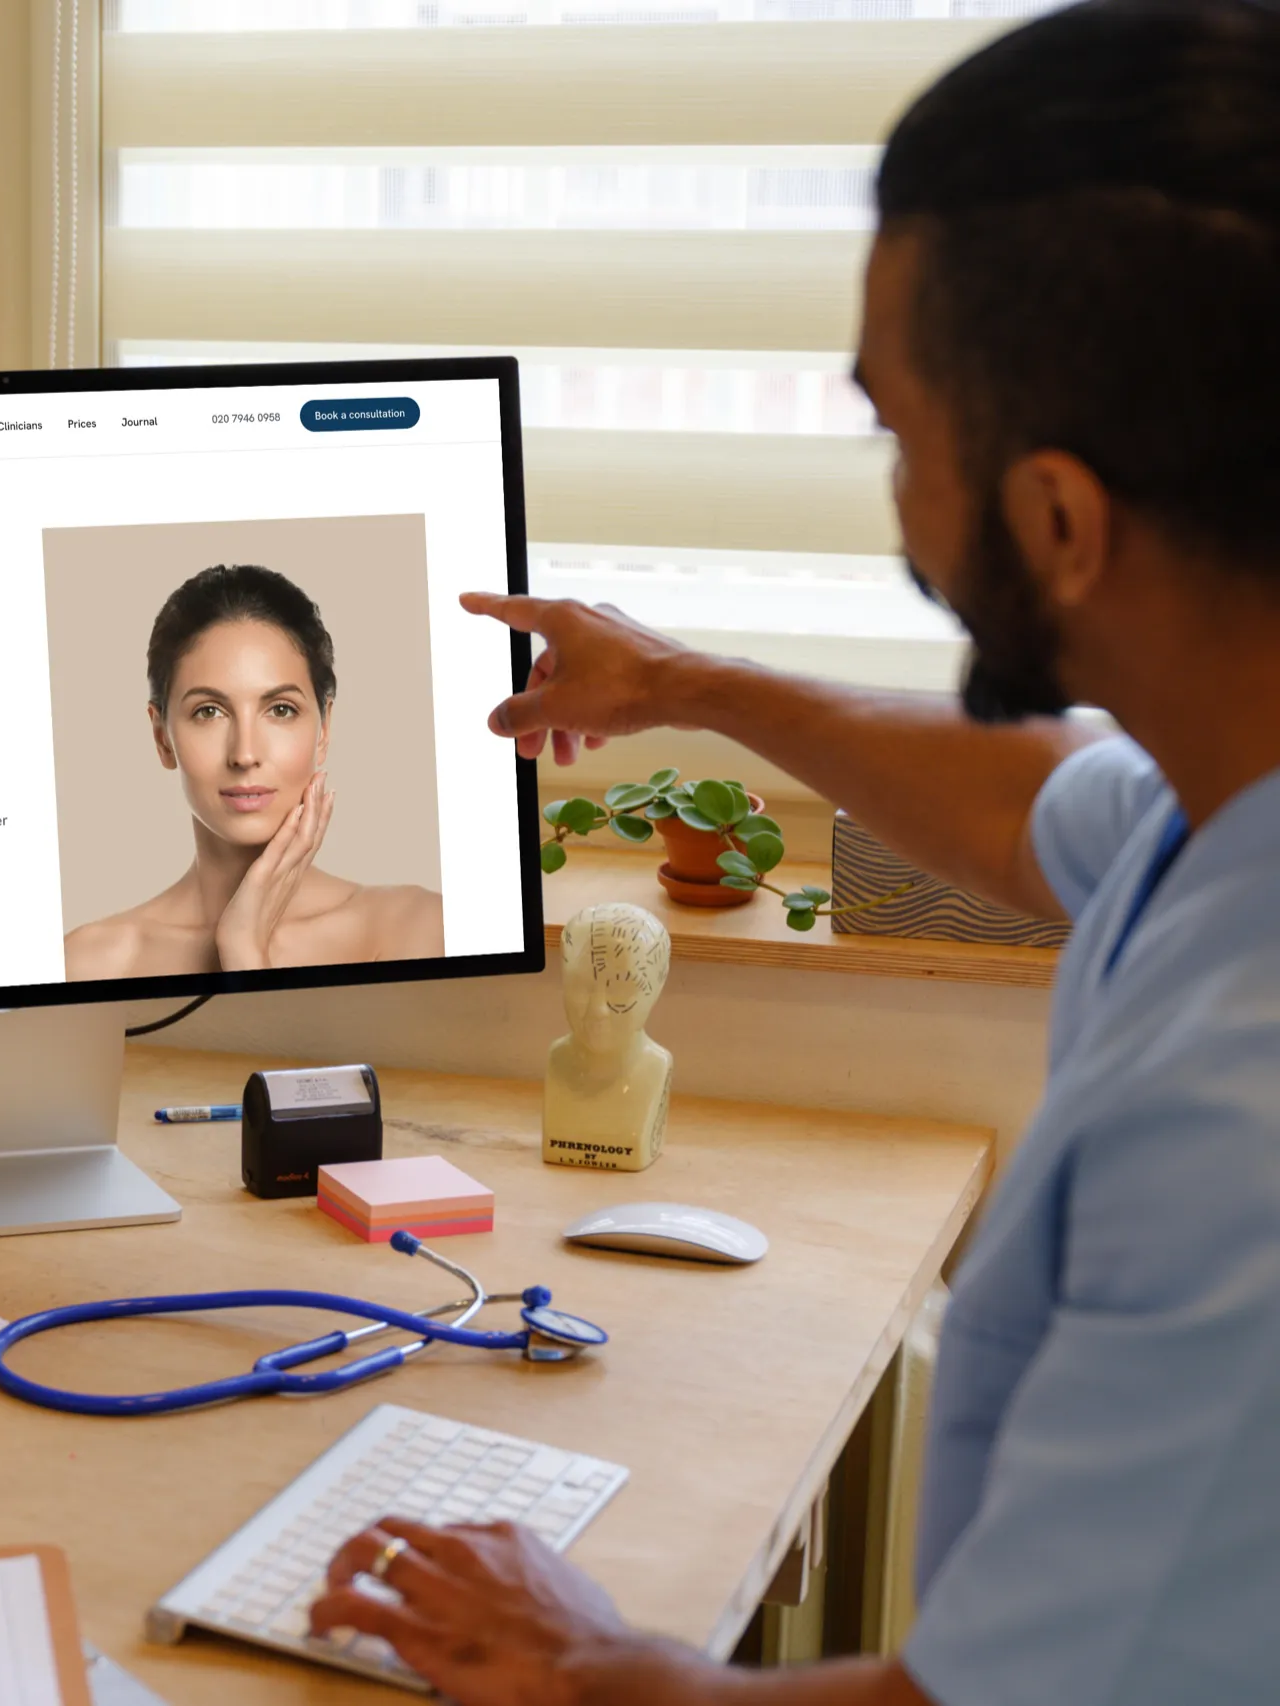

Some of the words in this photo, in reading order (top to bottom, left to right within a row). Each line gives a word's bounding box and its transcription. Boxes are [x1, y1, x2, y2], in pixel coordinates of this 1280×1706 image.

[211, 413, 230, 424] 020
[231, 413, 256, 424] 7946
[257, 412, 281, 423] 0958
[314, 410, 339, 421] Book
[340, 412, 348, 420] a
[348, 408, 406, 420] consultation
[67, 419, 97, 429] Prices
[121, 416, 158, 428] Journal
[549, 1139, 633, 1156] PHRENOLOGY
